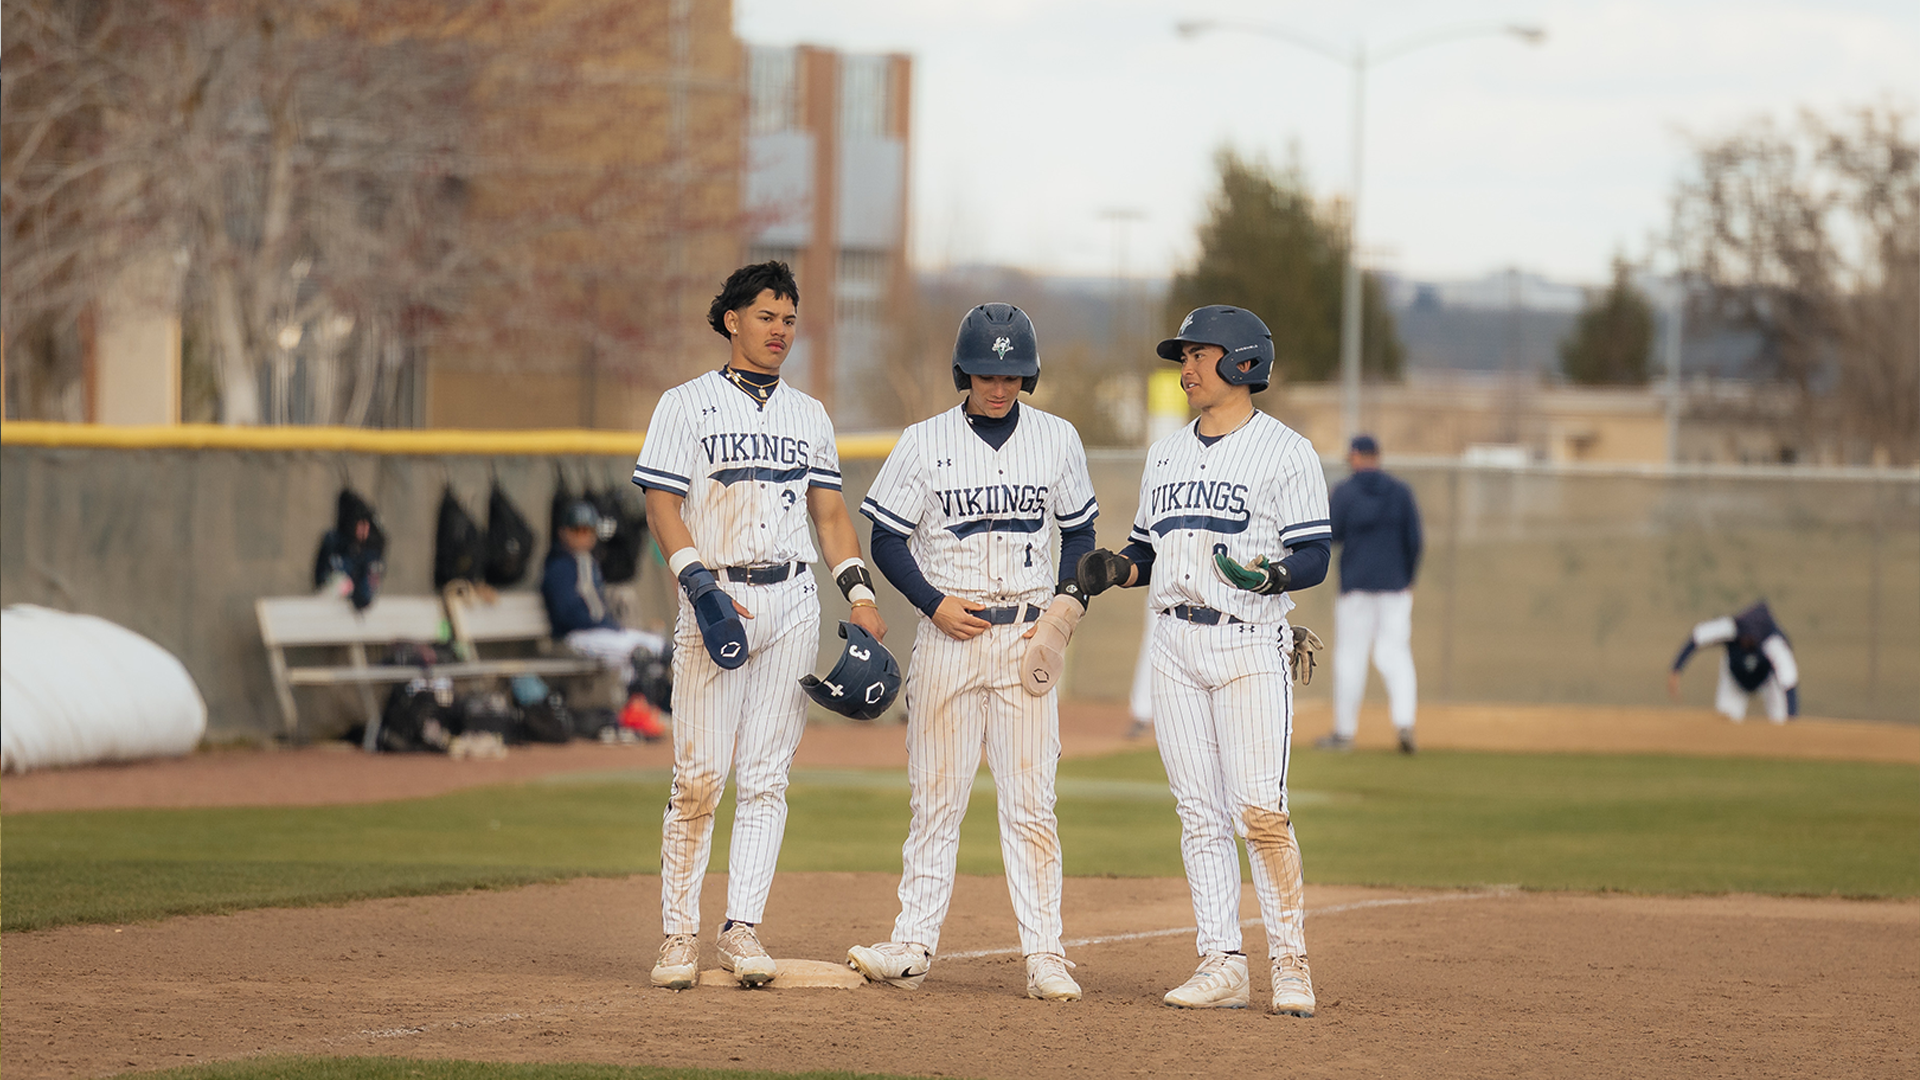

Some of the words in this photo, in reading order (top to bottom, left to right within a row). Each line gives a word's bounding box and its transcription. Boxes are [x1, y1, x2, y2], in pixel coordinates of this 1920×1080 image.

[701, 433, 809, 467] VIKINGS
[1151, 480, 1248, 515] VIKINGS
[1024, 542, 1033, 567] 1
[849, 645, 871, 661] 3
